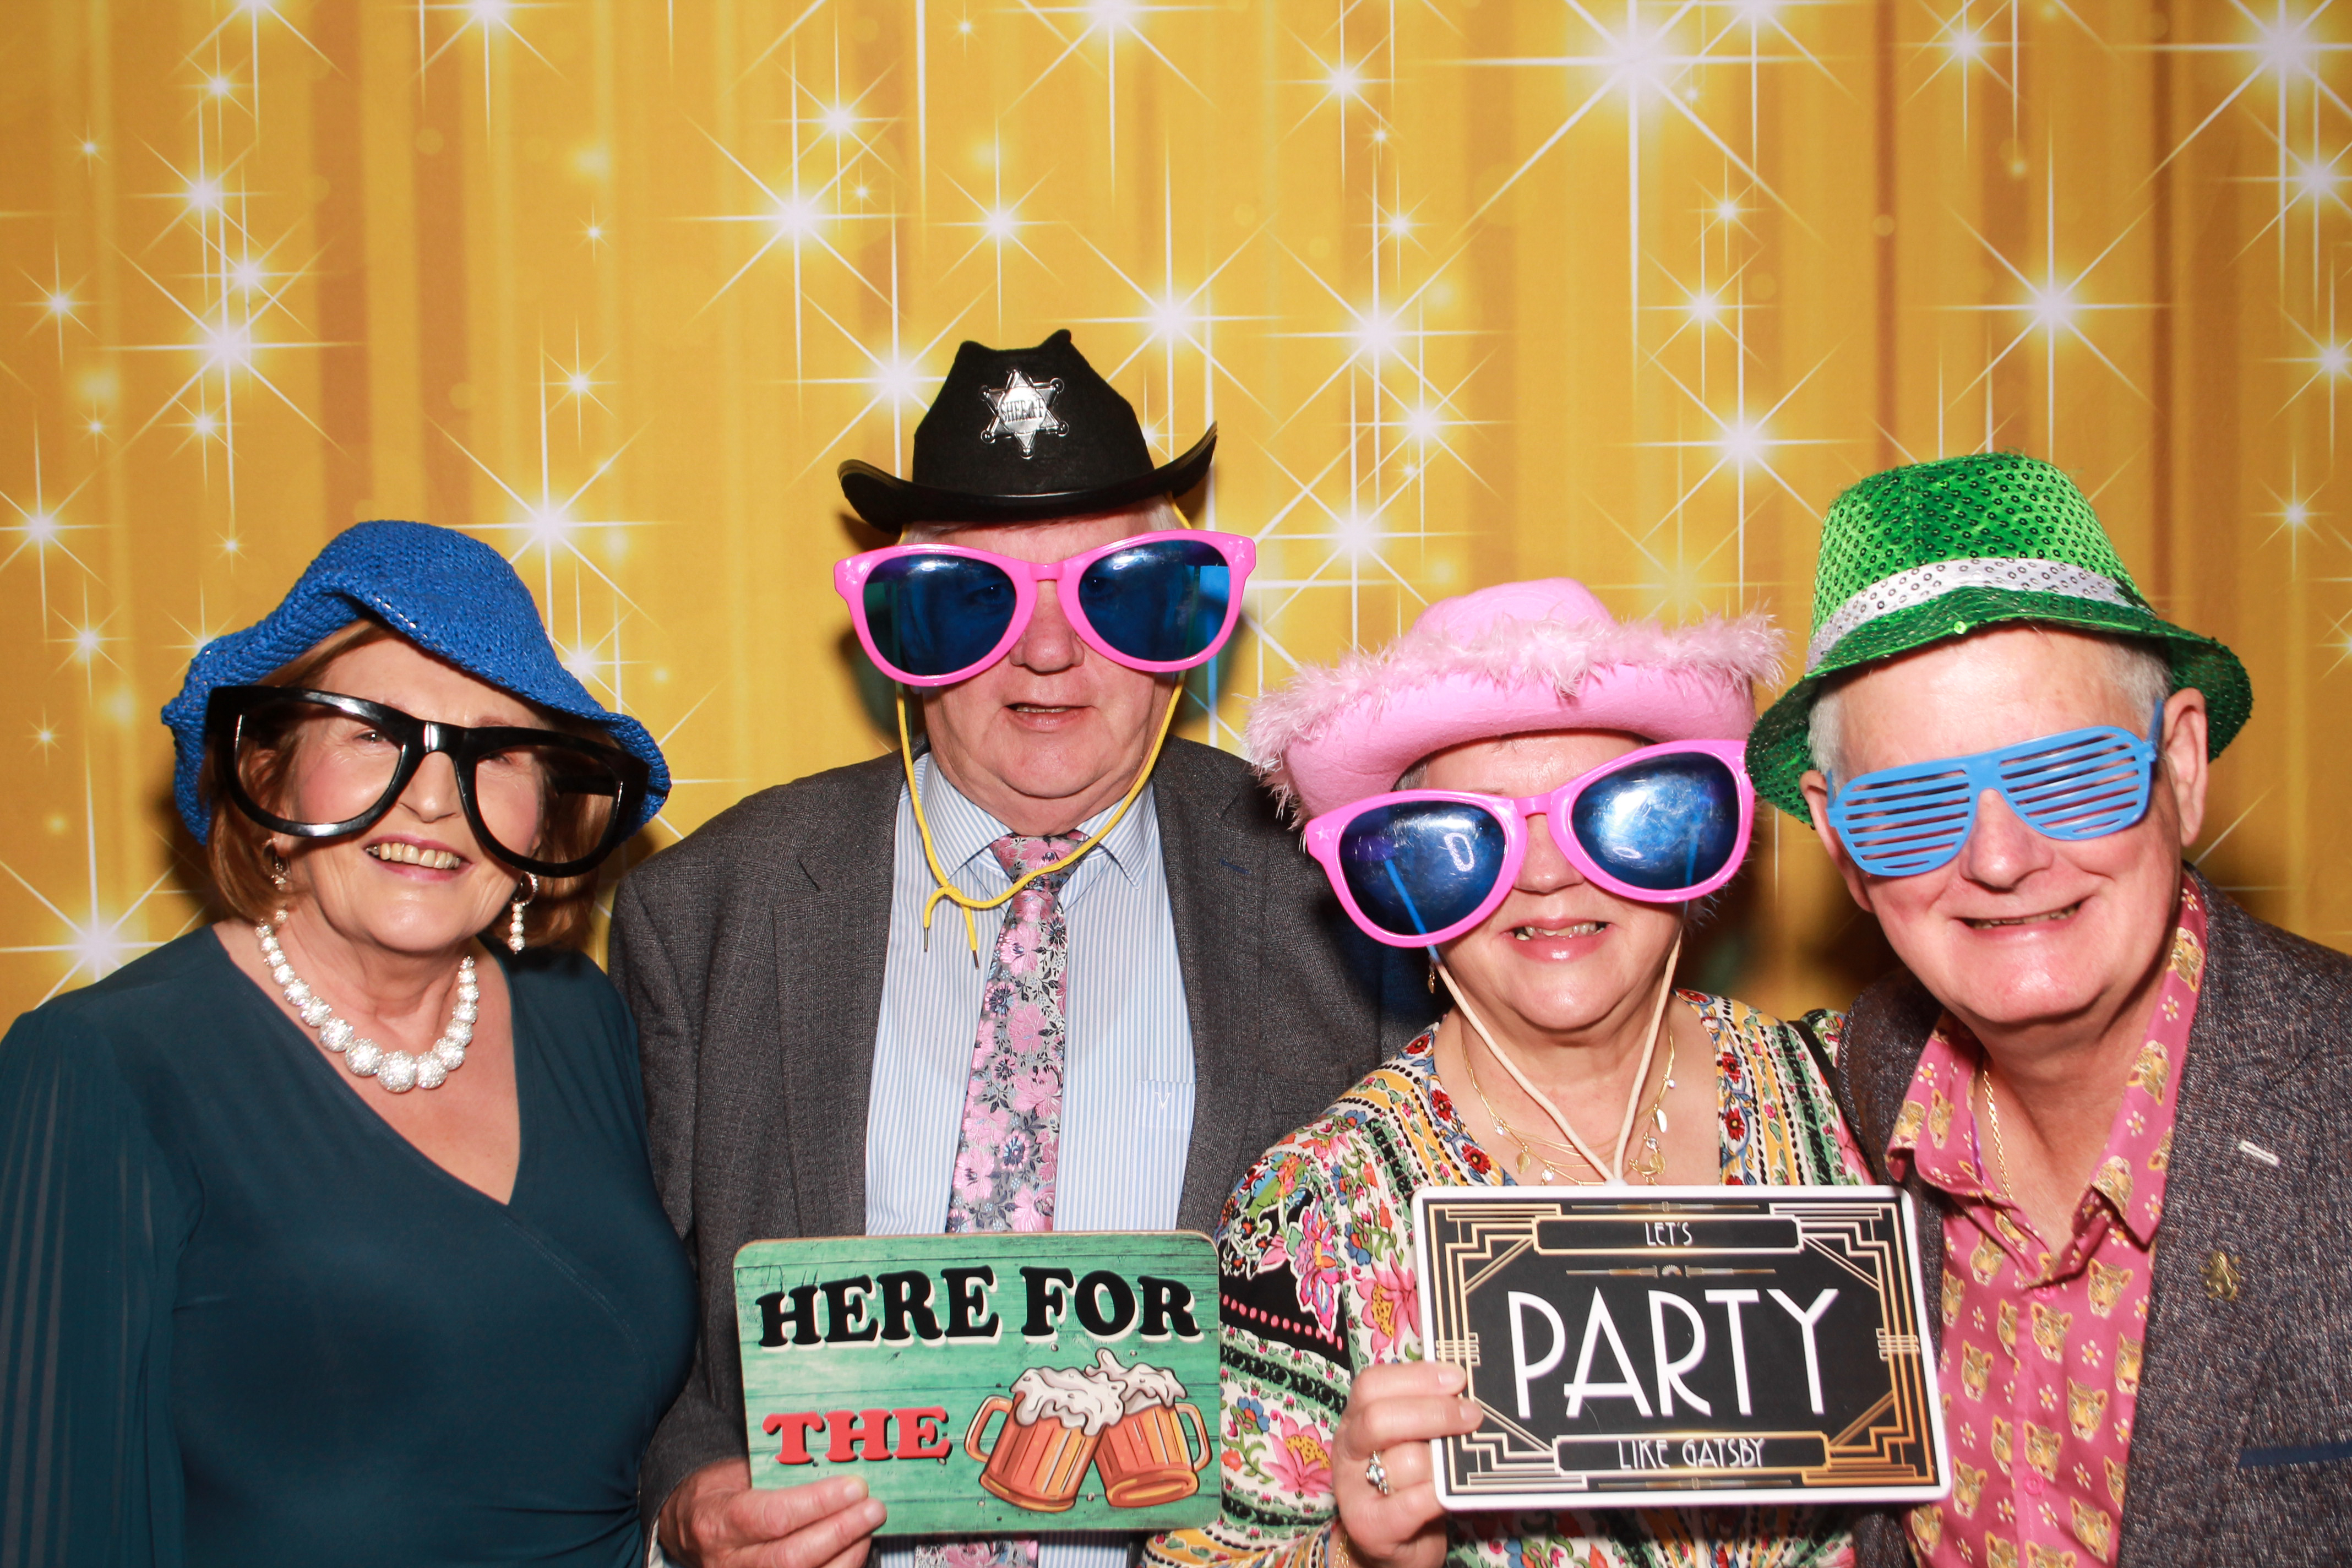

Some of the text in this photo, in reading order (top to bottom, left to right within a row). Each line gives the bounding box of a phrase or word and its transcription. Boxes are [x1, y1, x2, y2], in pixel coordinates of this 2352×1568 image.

[1000, 398, 1044, 423] SHERIFF
[1644, 1221, 1693, 1247] LET'S
[755, 1265, 1205, 1351] HERE FOR
[1507, 1286, 1839, 1420] PARTY
[762, 1406, 953, 1464] THE
[1617, 1437, 1766, 1469] LIKE GATSBY
